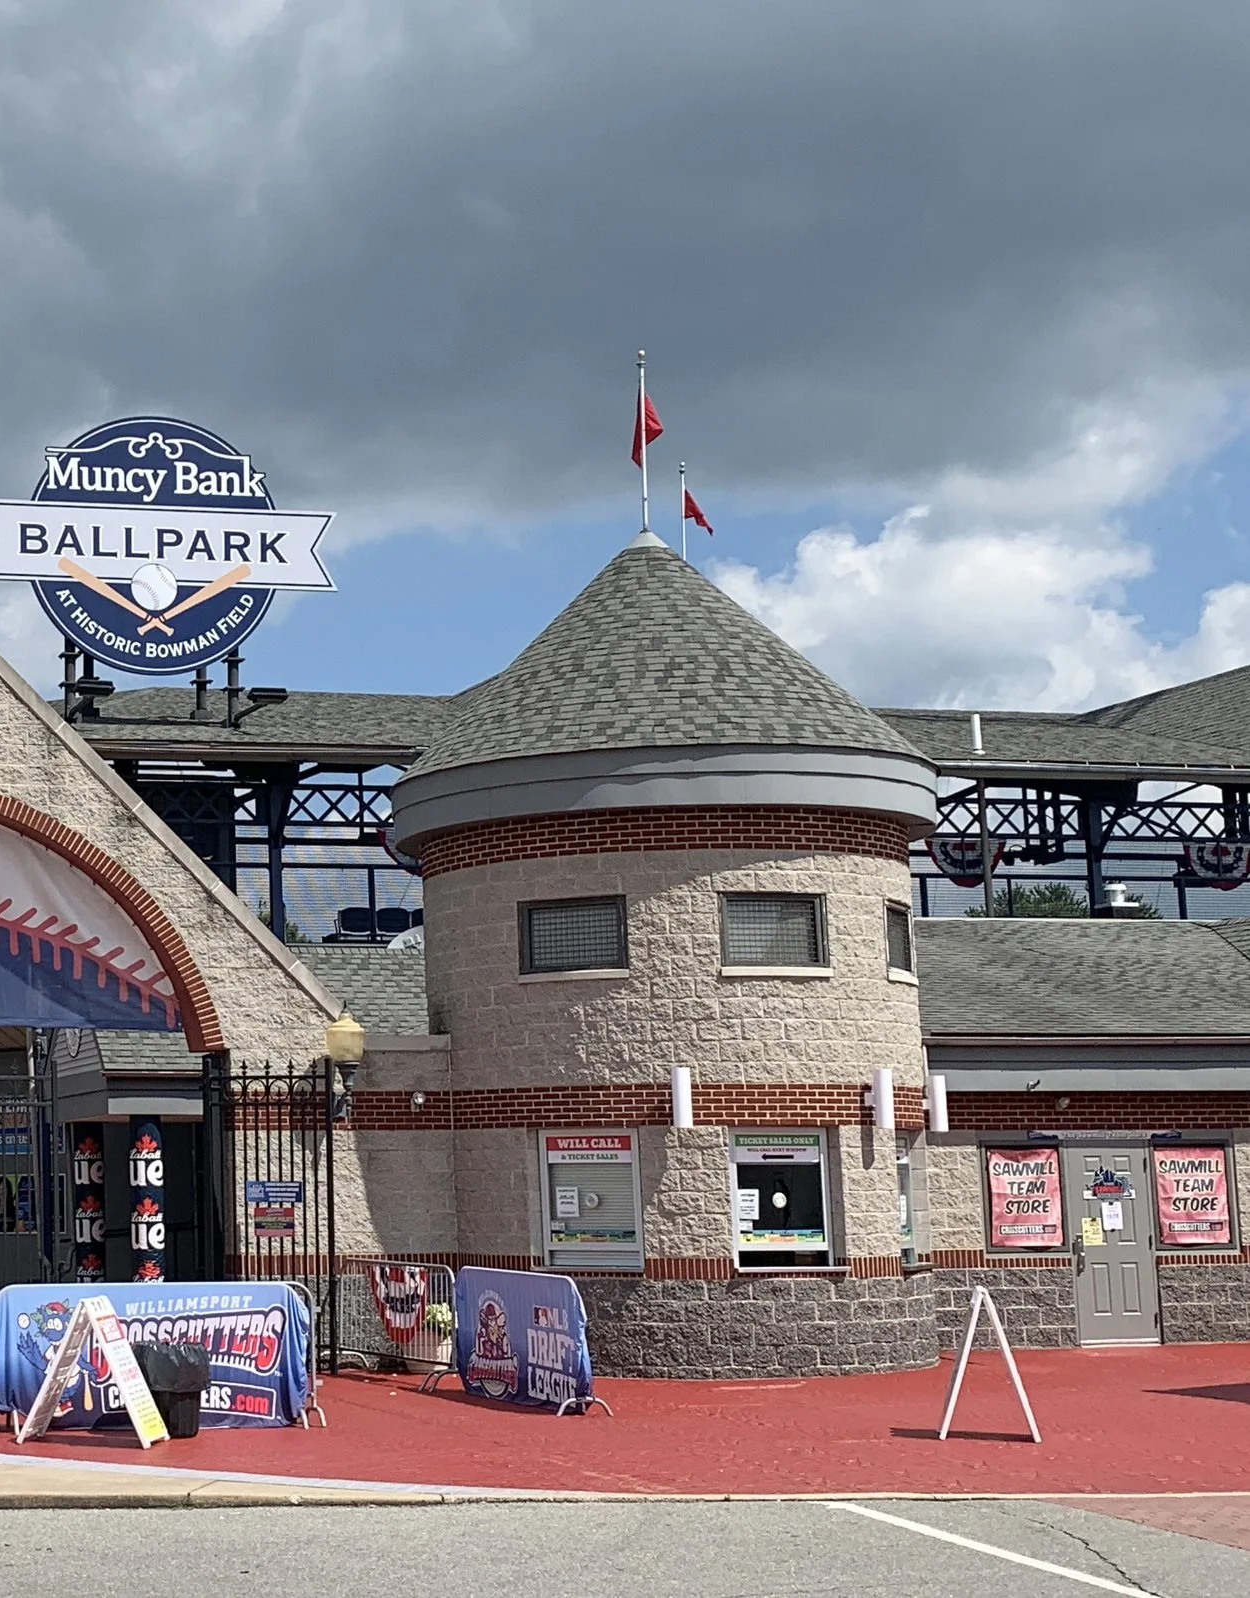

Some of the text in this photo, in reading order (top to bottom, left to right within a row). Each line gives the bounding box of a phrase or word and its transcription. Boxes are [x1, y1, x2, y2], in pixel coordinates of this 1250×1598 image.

[46, 456, 266, 501] Muncy Bank
[18, 522, 289, 564] BALLPARK
[56, 588, 255, 659] AT HISTORIC BOWMAN FIELD
[556, 1138, 622, 1149] WILL CALL
[739, 1137, 815, 1145] TICKET SALES ONLY
[992, 1160, 1055, 1177] SAWMILL
[1158, 1159, 1223, 1174] SAWMILL
[1007, 1180, 1046, 1195] TEAM
[1173, 1178, 1214, 1192] TEAM
[1005, 1199, 1050, 1215] STORE
[1172, 1197, 1218, 1212] STORE
[125, 1295, 253, 1317] WILLIAMSPORT
[527, 1328, 576, 1374] DRAFT
[527, 1365, 577, 1408] LEAGUE
